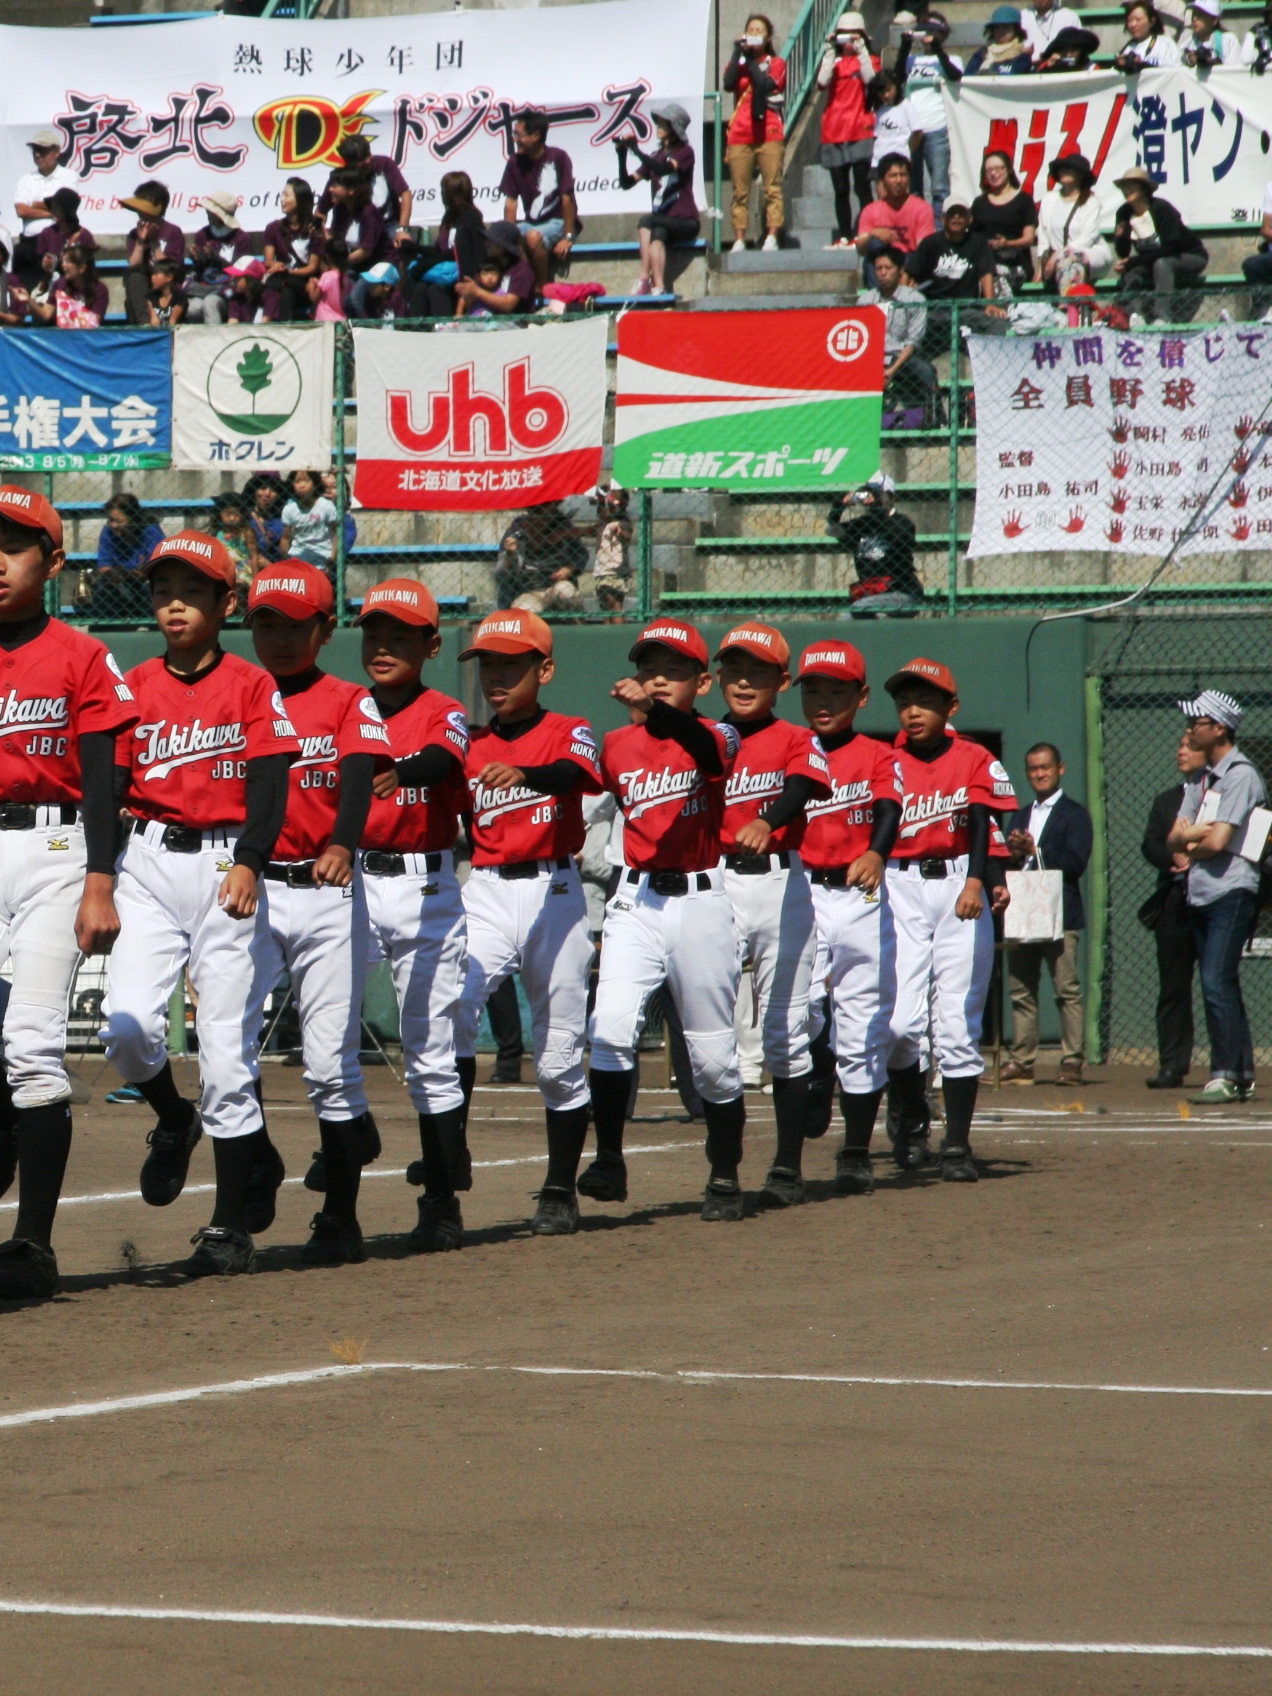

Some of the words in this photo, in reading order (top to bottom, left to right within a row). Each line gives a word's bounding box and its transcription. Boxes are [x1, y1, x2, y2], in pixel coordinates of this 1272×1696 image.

[232, 39, 465, 77] 熱球少年団
[249, 190, 271, 208] of
[1031, 332, 1265, 370] 仲間を信じて
[1011, 374, 1196, 411] 全員野球
[386, 356, 570, 458] uhb
[208, 440, 296, 462] ホクレン
[644, 445, 849, 480] 道新スポーツ
[398, 466, 544, 493] 北海道文化放送
[159, 539, 214, 560] TAKIKAWA
[255, 577, 306, 596] TAKIKAWA
[368, 589, 419, 607] TAKIKAWA
[727, 630, 773, 648] TAKIKAWA
[804, 649, 847, 667] TAKIKAWA
[26, 735, 68, 757] JBC
[134, 719, 248, 766] Takikawa
[211, 760, 248, 780] JBC
[300, 770, 337, 790] JBC
[396, 787, 430, 807] JBC
[531, 803, 564, 825] JBC
[846, 809, 874, 826] JBC
